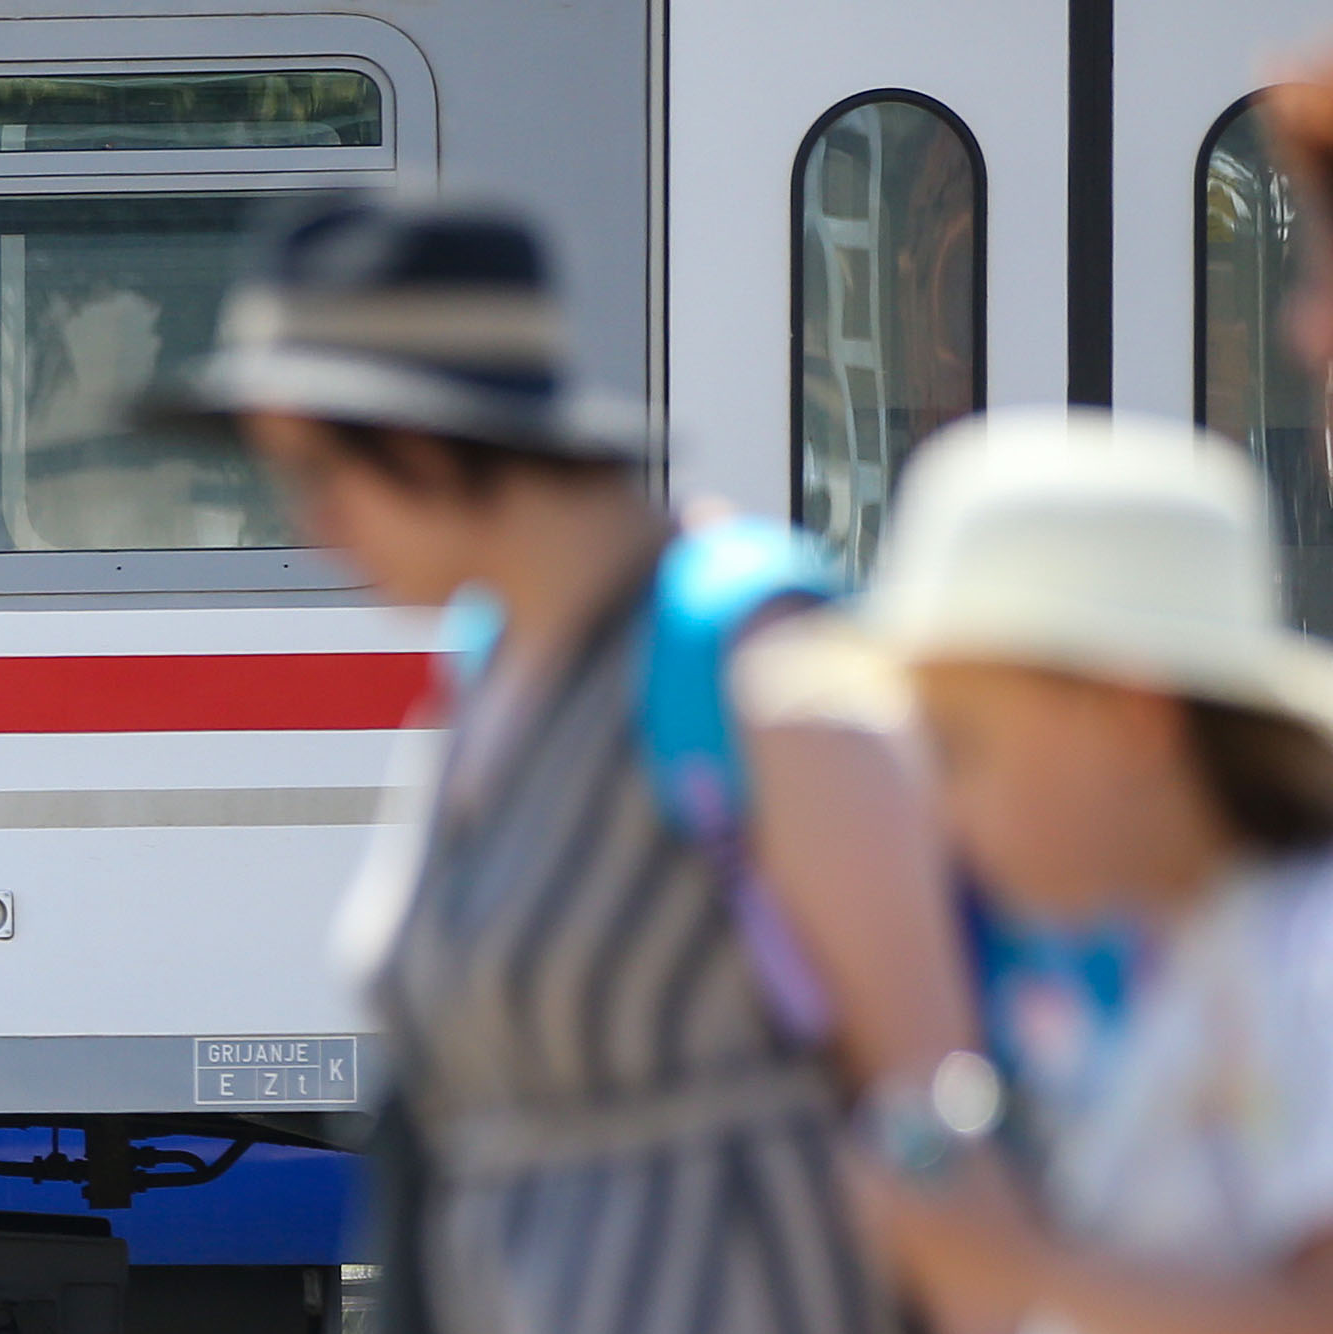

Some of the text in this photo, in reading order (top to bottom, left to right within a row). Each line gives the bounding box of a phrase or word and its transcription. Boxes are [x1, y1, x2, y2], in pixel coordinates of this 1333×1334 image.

[208, 1043, 309, 1063] GRIJANJE
[329, 1058, 344, 1081] K
[220, 1074, 235, 1096] E
[263, 1073, 278, 1096] Z
